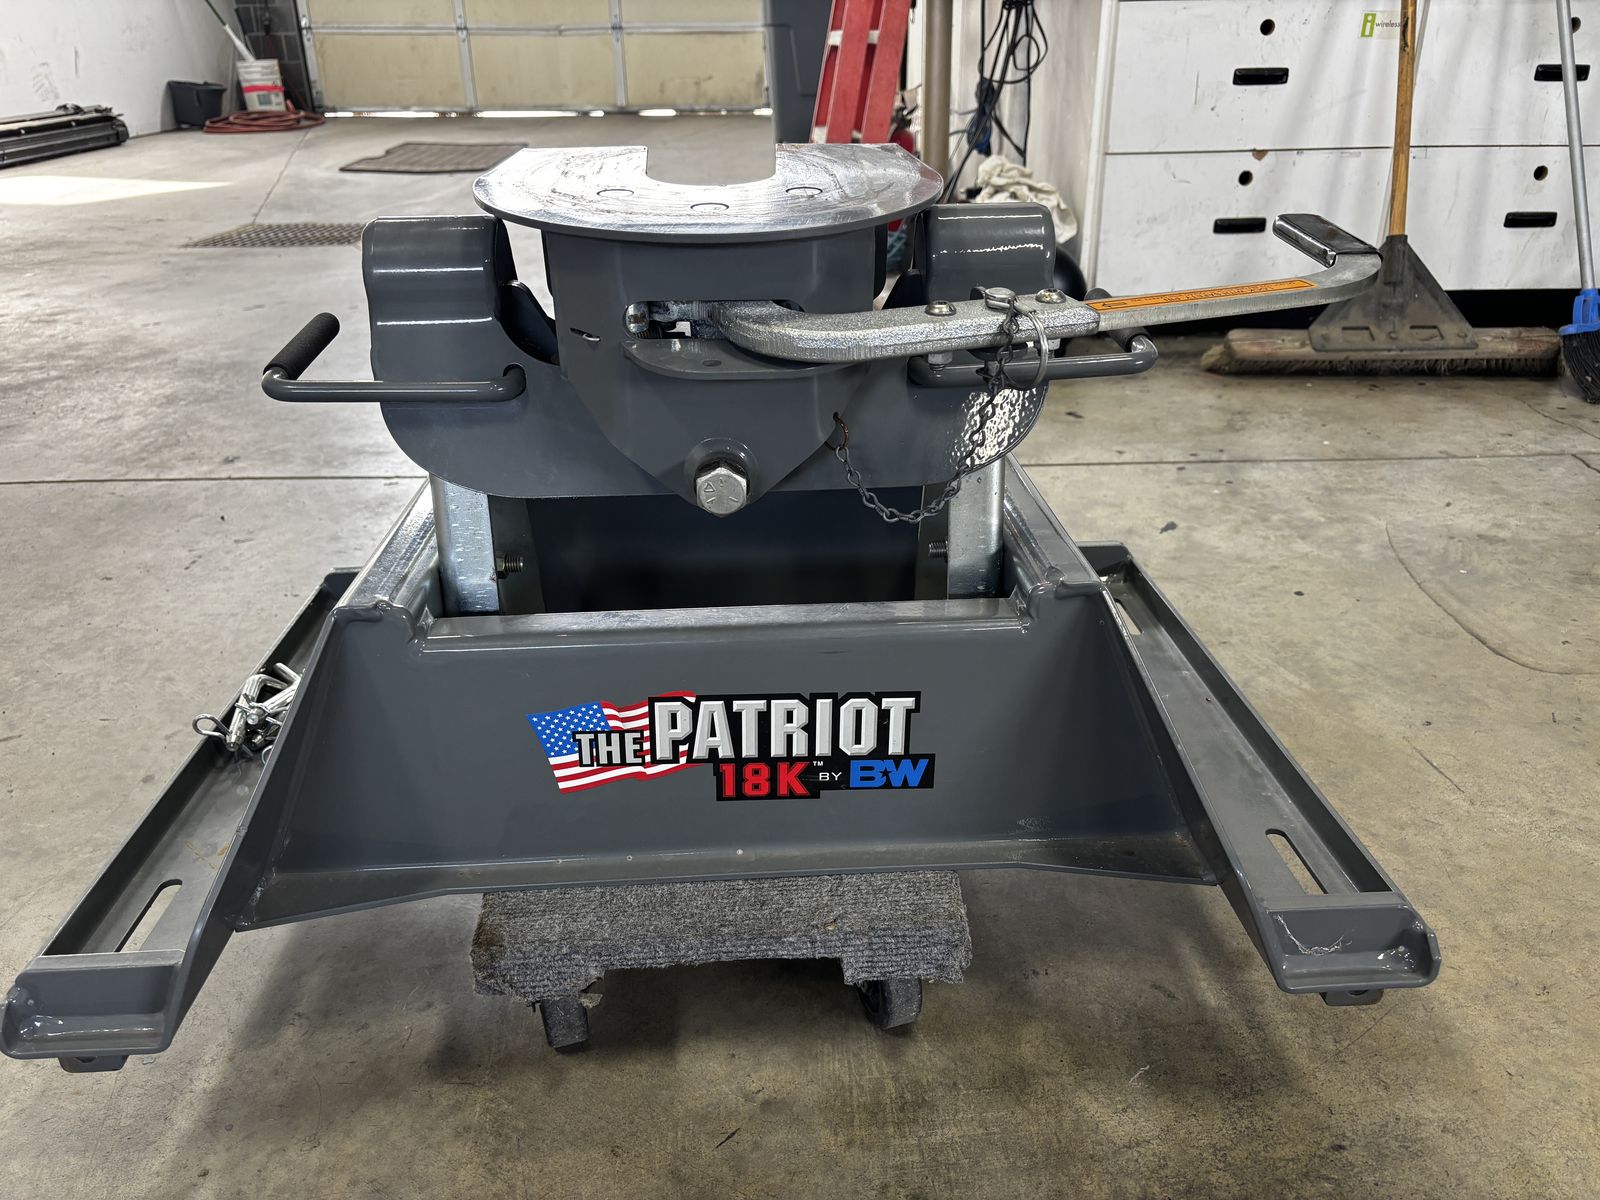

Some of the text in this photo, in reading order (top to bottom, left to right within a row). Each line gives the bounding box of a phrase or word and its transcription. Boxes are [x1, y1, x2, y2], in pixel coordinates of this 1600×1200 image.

[1376, 20, 1401, 28] wireless
[575, 697, 916, 765] THE PATRIOT
[719, 761, 811, 798] 18K
[819, 772, 842, 781] BY
